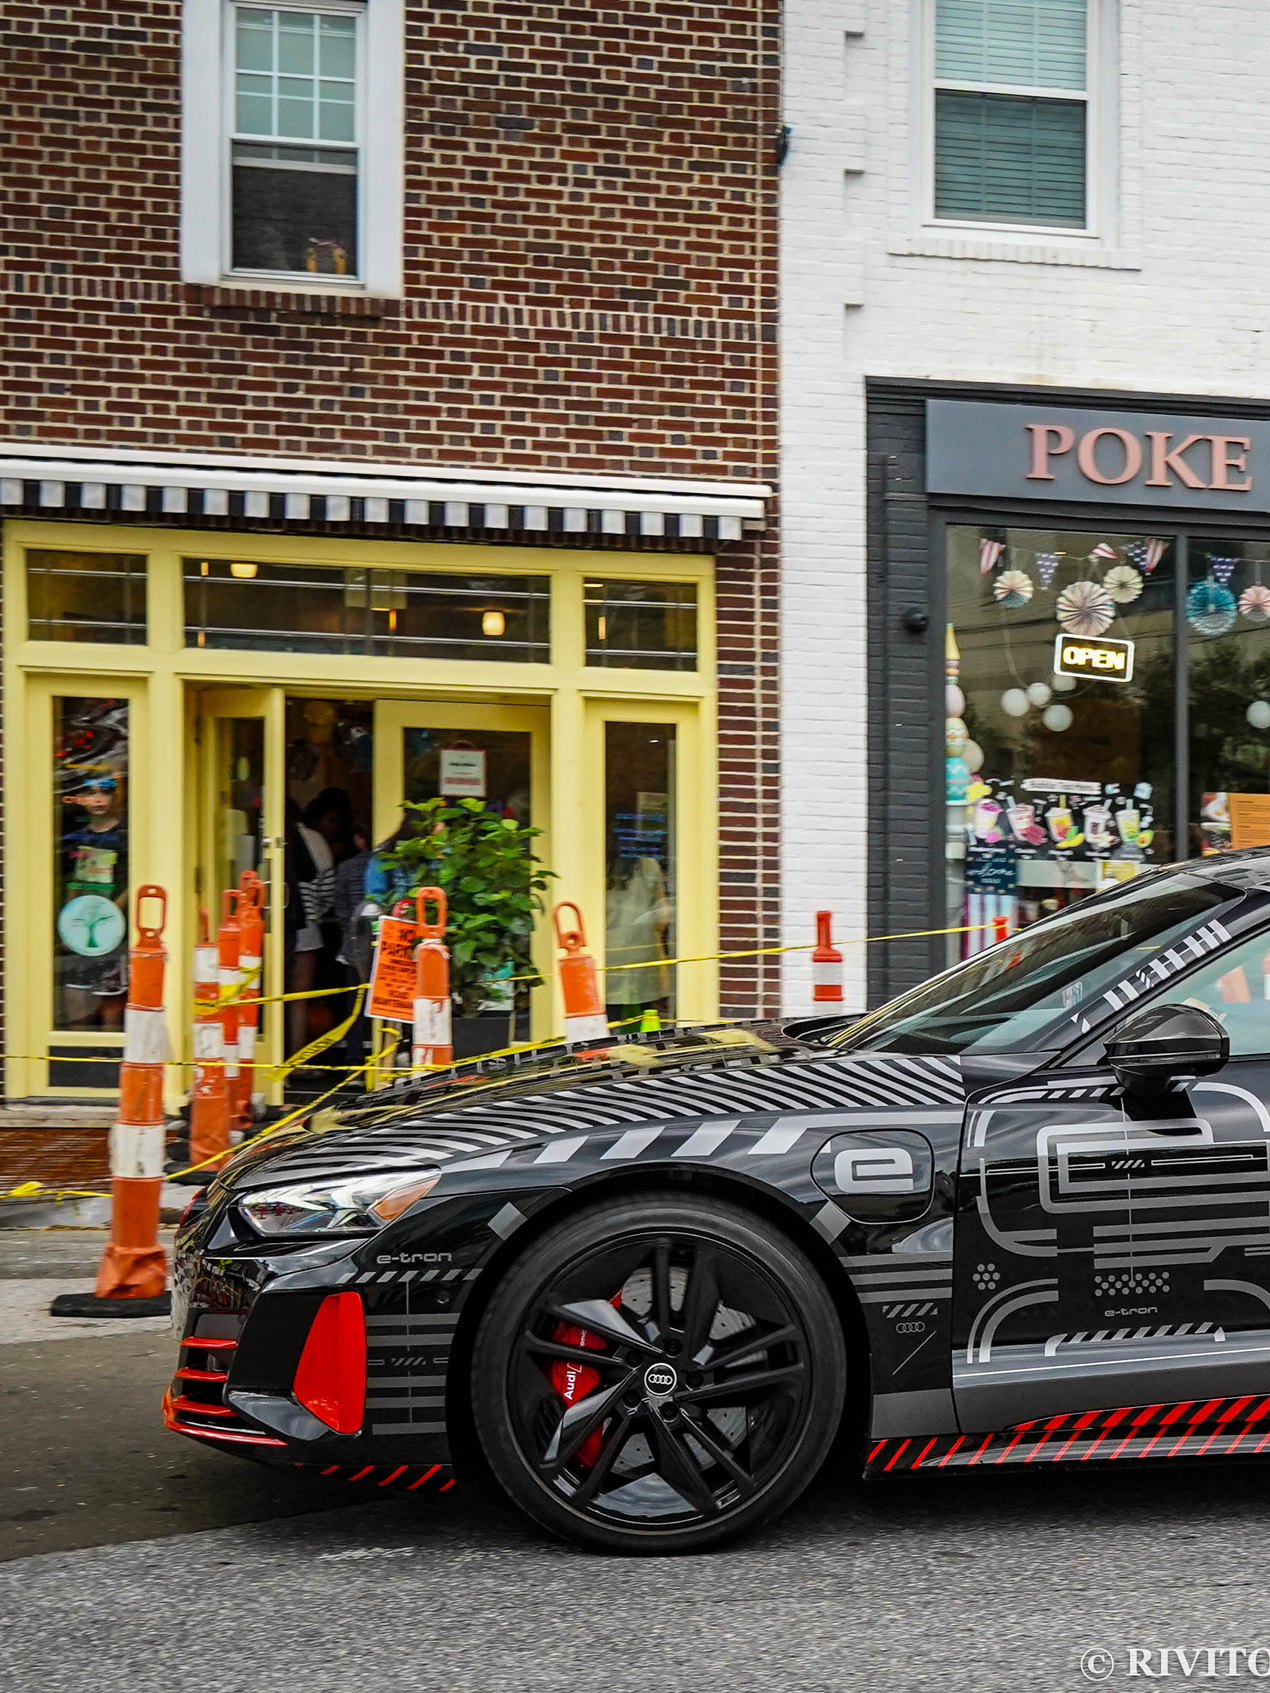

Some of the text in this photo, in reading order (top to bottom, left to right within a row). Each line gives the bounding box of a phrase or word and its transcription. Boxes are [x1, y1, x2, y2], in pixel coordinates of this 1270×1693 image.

[1025, 424, 1253, 491] POKE
[1062, 646, 1125, 670] OPEN
[376, 1252, 452, 1264] e-tron
[1104, 1306, 1158, 1317] e-tron
[563, 1370, 577, 1400] Audi
